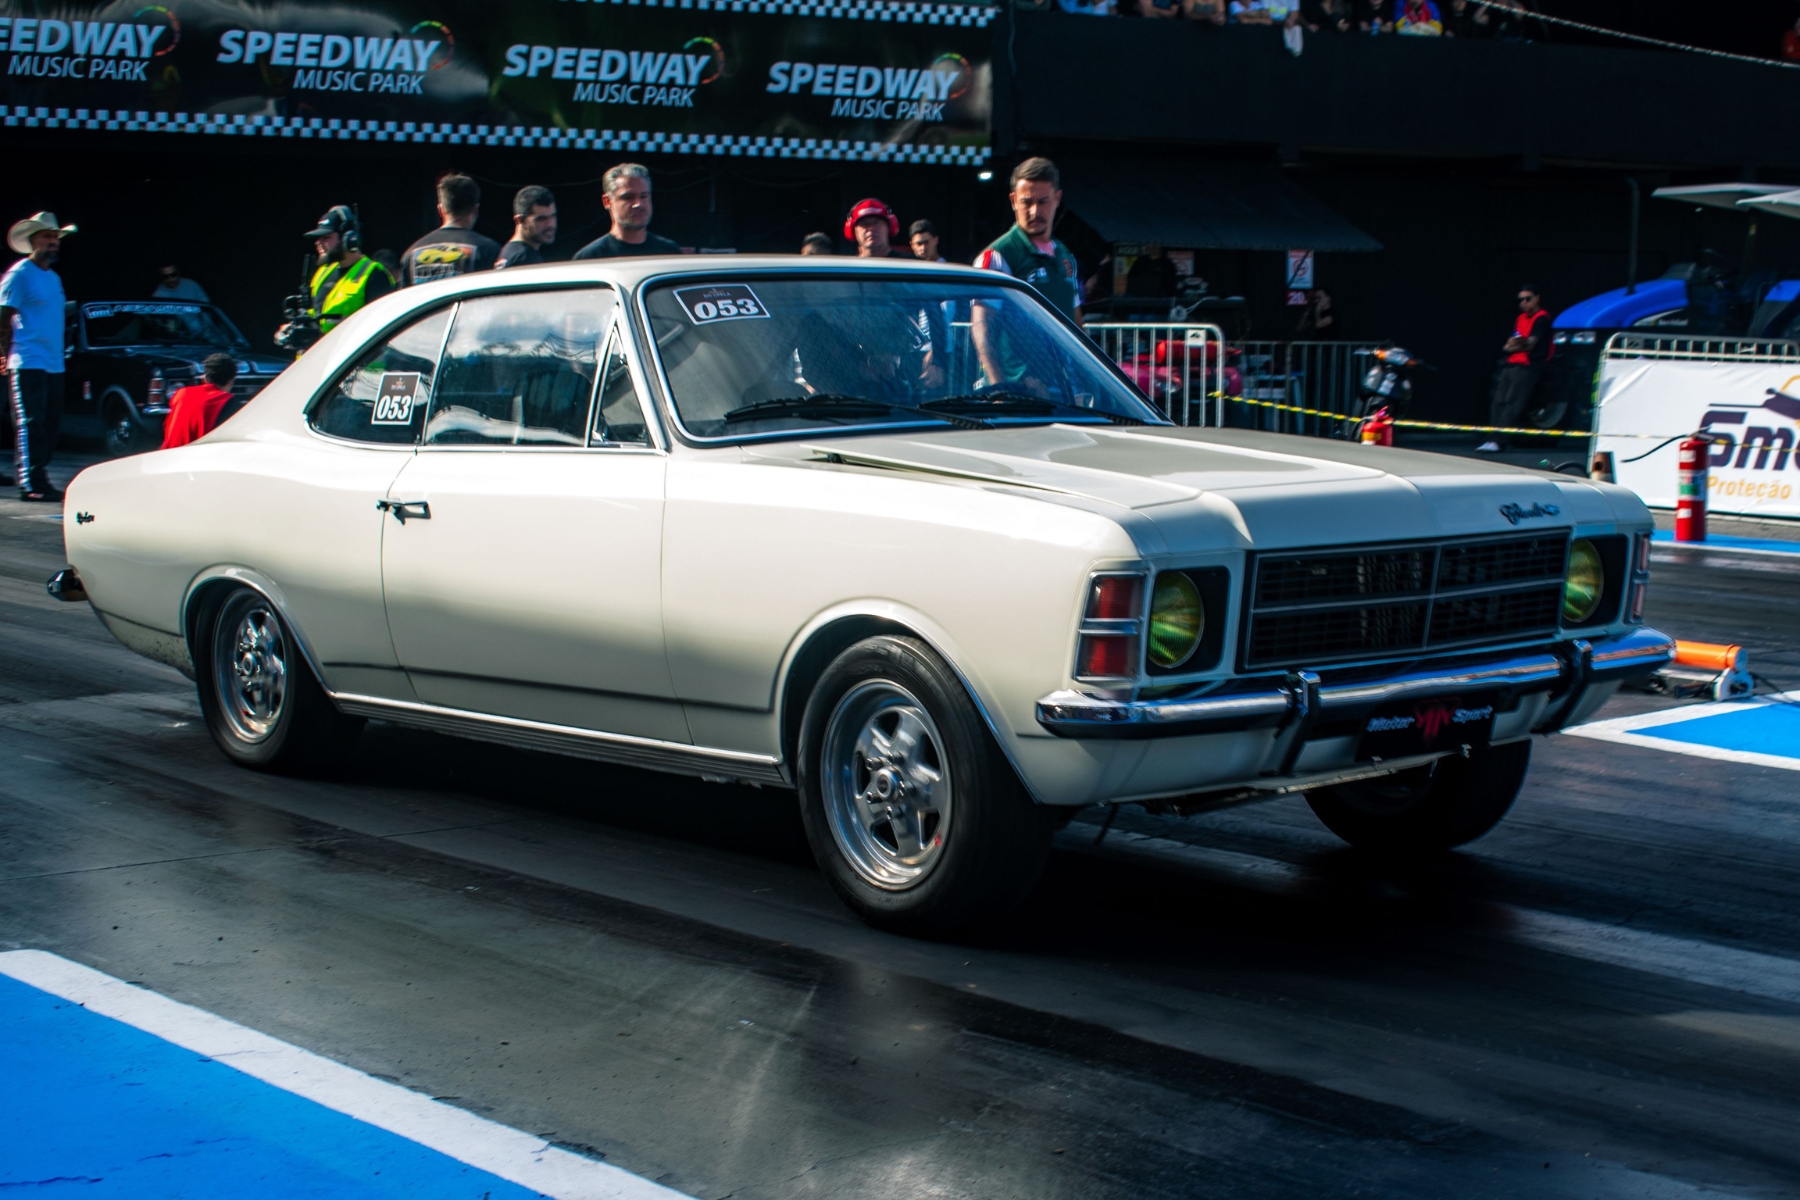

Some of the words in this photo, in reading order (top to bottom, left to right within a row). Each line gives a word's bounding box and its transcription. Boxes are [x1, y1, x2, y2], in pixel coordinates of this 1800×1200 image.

[216, 29, 442, 72] SPEEDWAY
[7, 54, 87, 78] MUSIC
[88, 58, 149, 82] PARK
[502, 44, 711, 87] SPEEDWAY
[293, 68, 367, 92] MUSIC
[368, 72, 426, 95] PARK
[765, 61, 960, 101] SPEEDWAY
[572, 82, 642, 105] MUSIC
[642, 86, 696, 108] PARK
[831, 98, 896, 120] MUSIC
[896, 101, 946, 122] PARK
[693, 298, 760, 320] 053
[376, 395, 412, 420] 053
[1699, 410, 1800, 471] Sm
